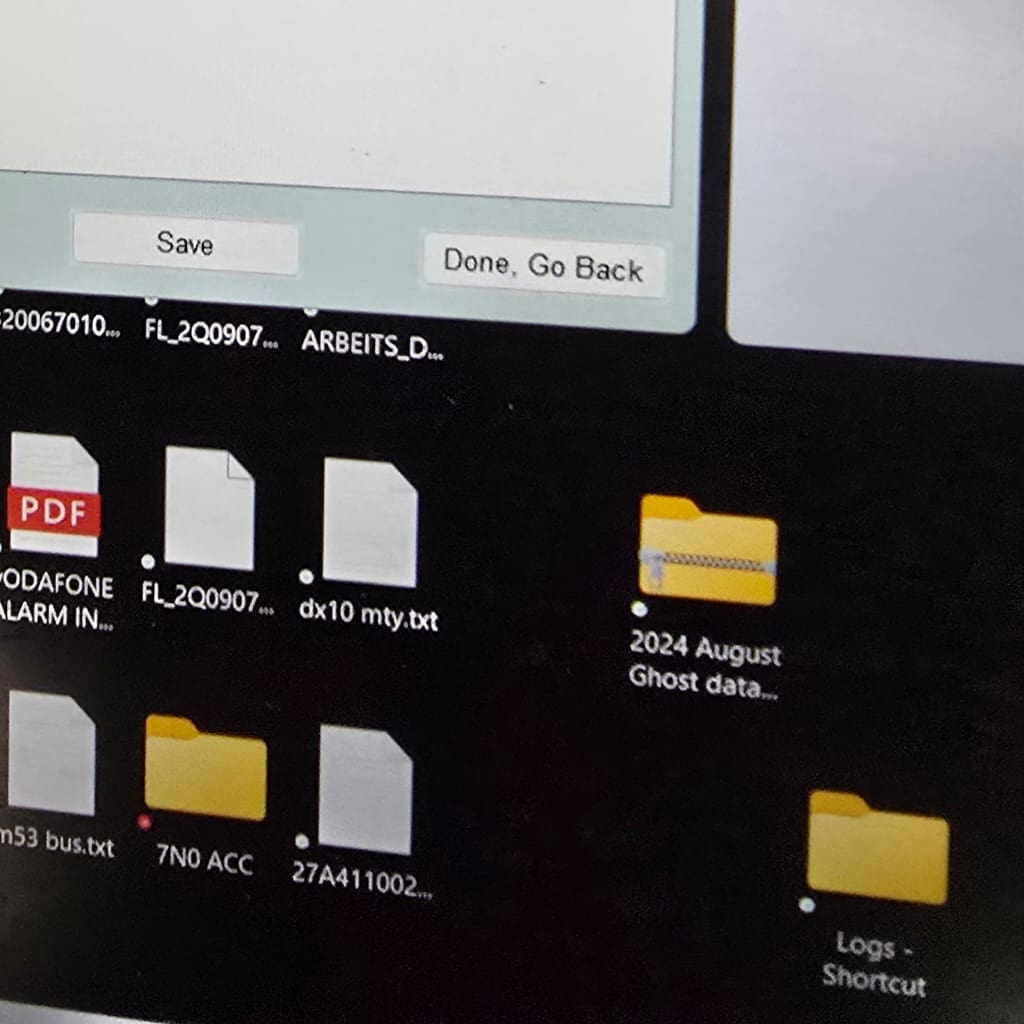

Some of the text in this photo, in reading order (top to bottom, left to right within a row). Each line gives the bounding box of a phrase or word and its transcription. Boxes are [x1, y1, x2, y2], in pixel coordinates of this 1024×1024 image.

[156, 231, 214, 257] Save
[444, 247, 645, 283] Done, Go Back
[20, 497, 87, 527] PDF
[299, 598, 440, 634] dx10 mty.txt
[629, 629, 783, 668] 2024 August
[628, 664, 699, 693] Ghost
[45, 829, 115, 859] bus.txt
[207, 850, 255, 877] ACC
[836, 931, 896, 962] Logs
[822, 964, 927, 998] Shortcut
